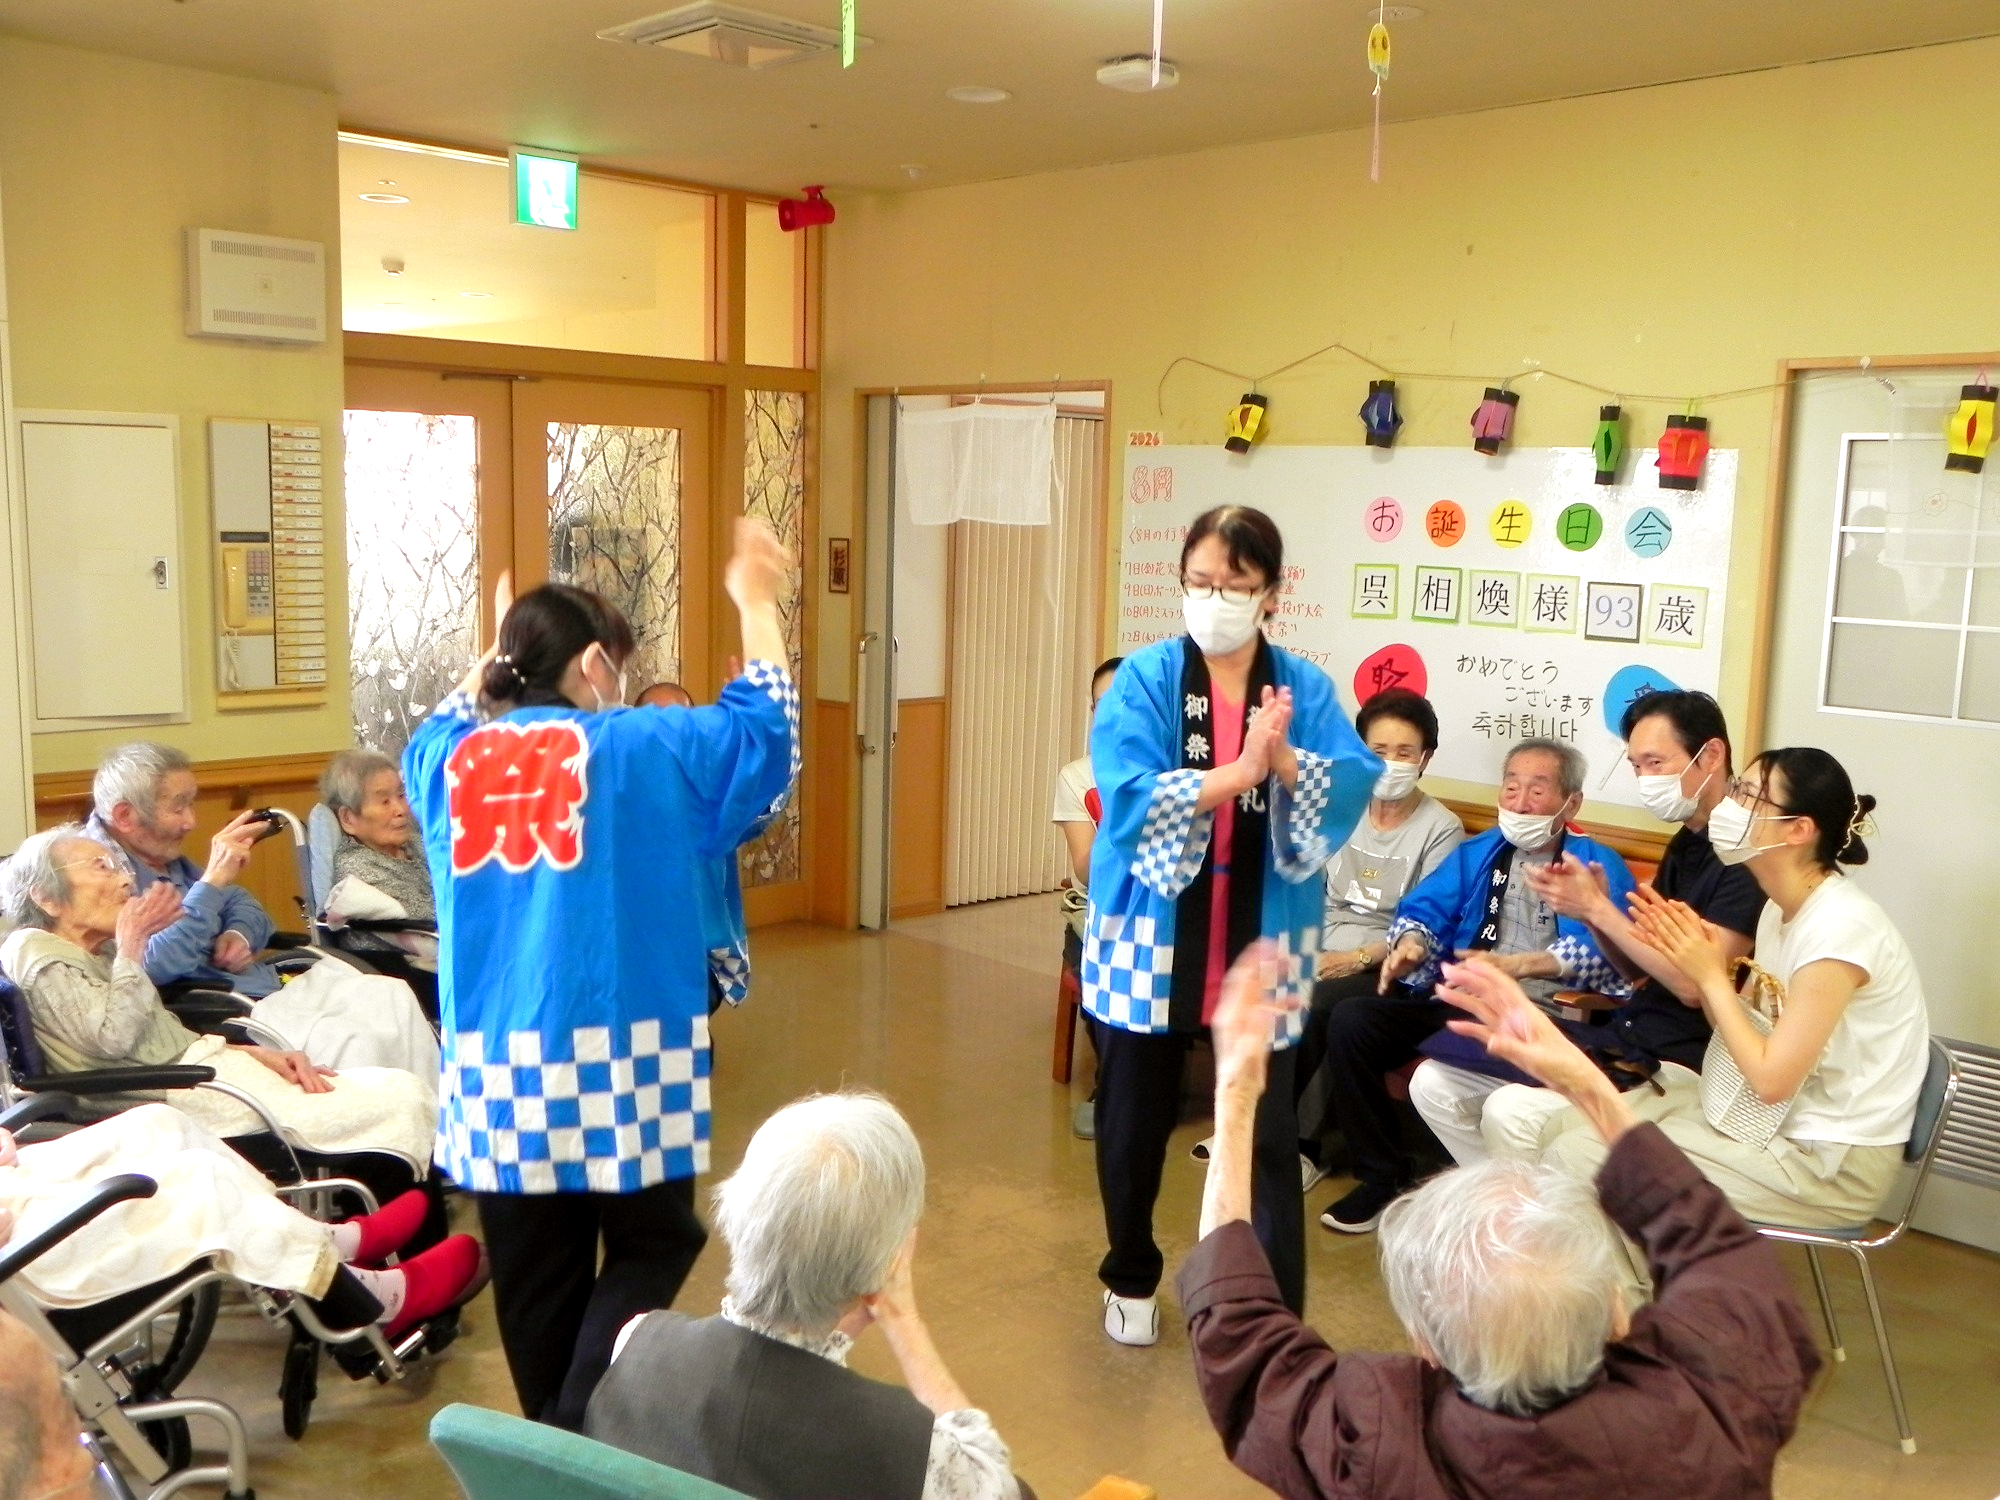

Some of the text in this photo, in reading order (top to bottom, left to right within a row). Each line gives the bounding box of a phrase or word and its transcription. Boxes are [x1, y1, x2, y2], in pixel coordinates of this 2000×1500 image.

[1129, 432, 1160, 446] 2026
[1130, 465, 1173, 503] 8月
[1372, 501, 1672, 550] お誕生日会
[1125, 561, 1181, 577] 7日(金)花火
[1276, 600, 1324, 619] 投げ大会
[1457, 654, 1560, 685] おめでとう
[1505, 686, 1594, 717] ございます
[1472, 711, 1578, 742] 축하합니다
